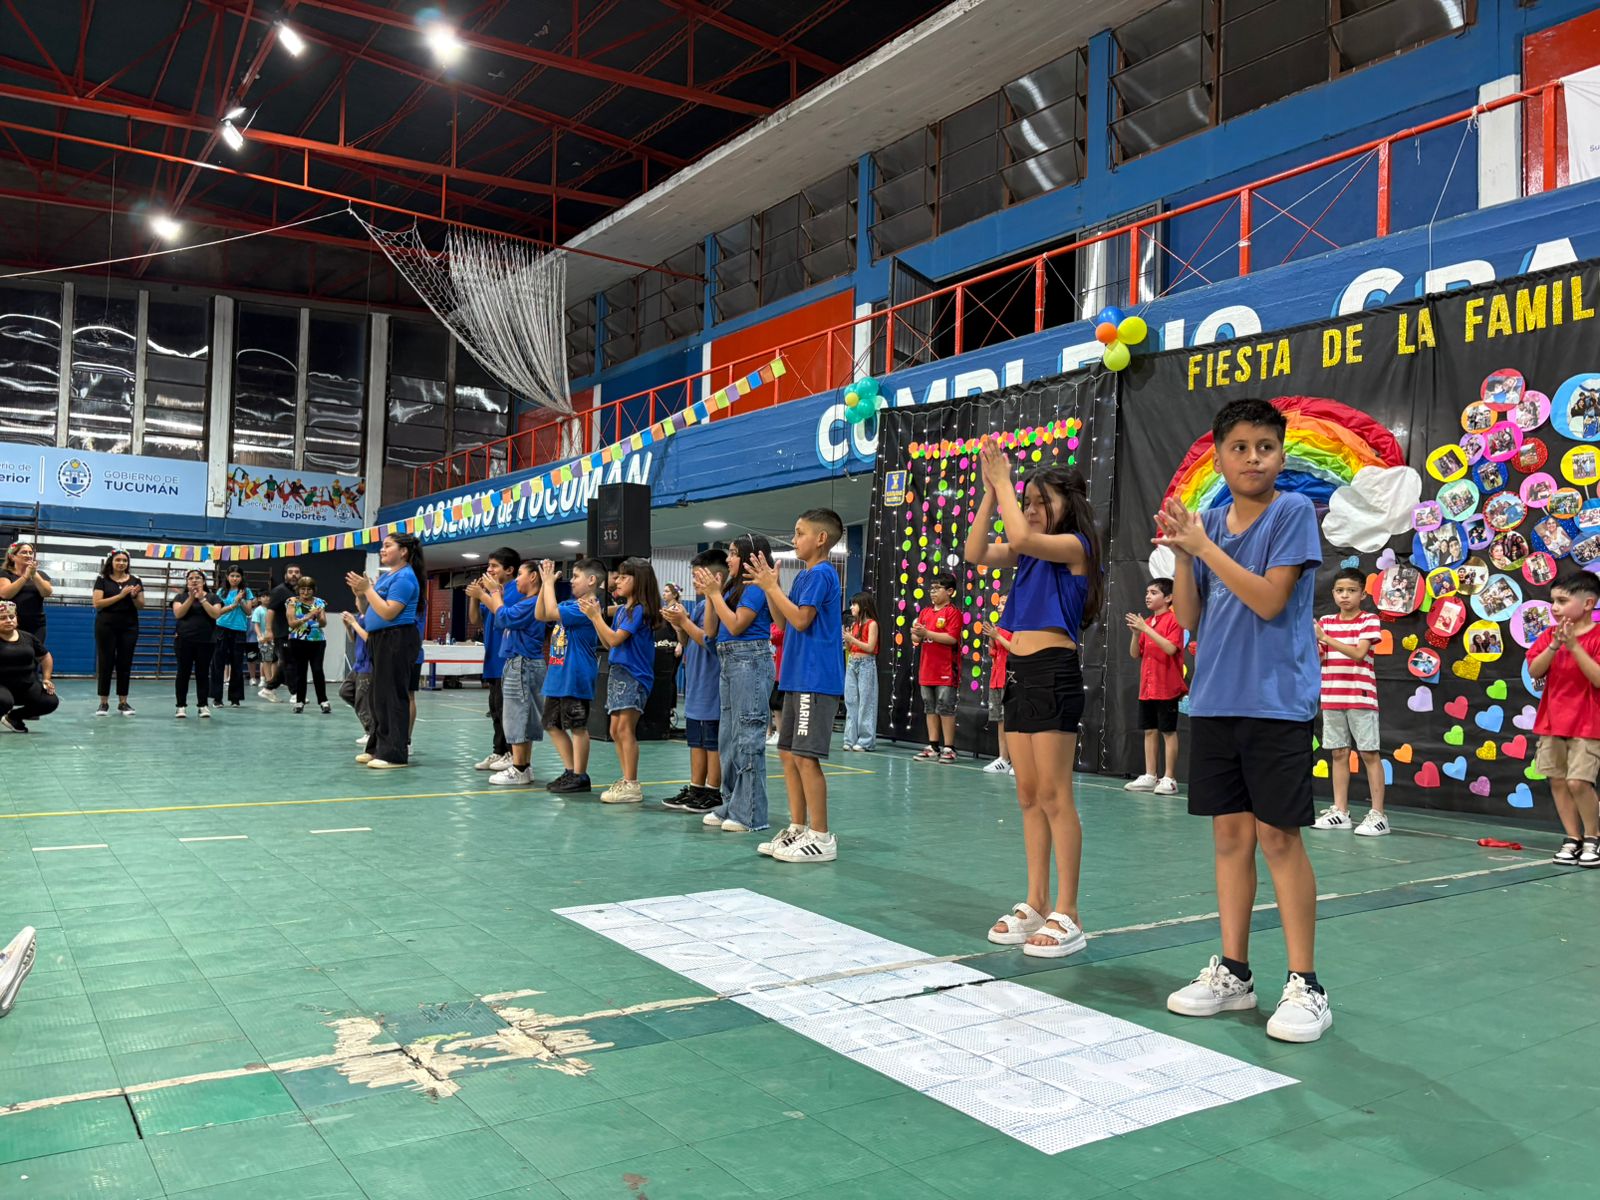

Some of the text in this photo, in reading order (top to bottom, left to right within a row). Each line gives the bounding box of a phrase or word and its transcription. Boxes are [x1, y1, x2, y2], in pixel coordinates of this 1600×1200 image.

[1188, 338, 1291, 391] FIESTA
[1322, 323, 1364, 368] DE
[1397, 307, 1436, 355] LA
[104, 470, 179, 484] GOBIERNO DE
[104, 480, 179, 496] TUCUMÁN
[281, 511, 327, 522] Deportes
[603, 529, 619, 540] STS
[797, 693, 811, 736] MARINE
